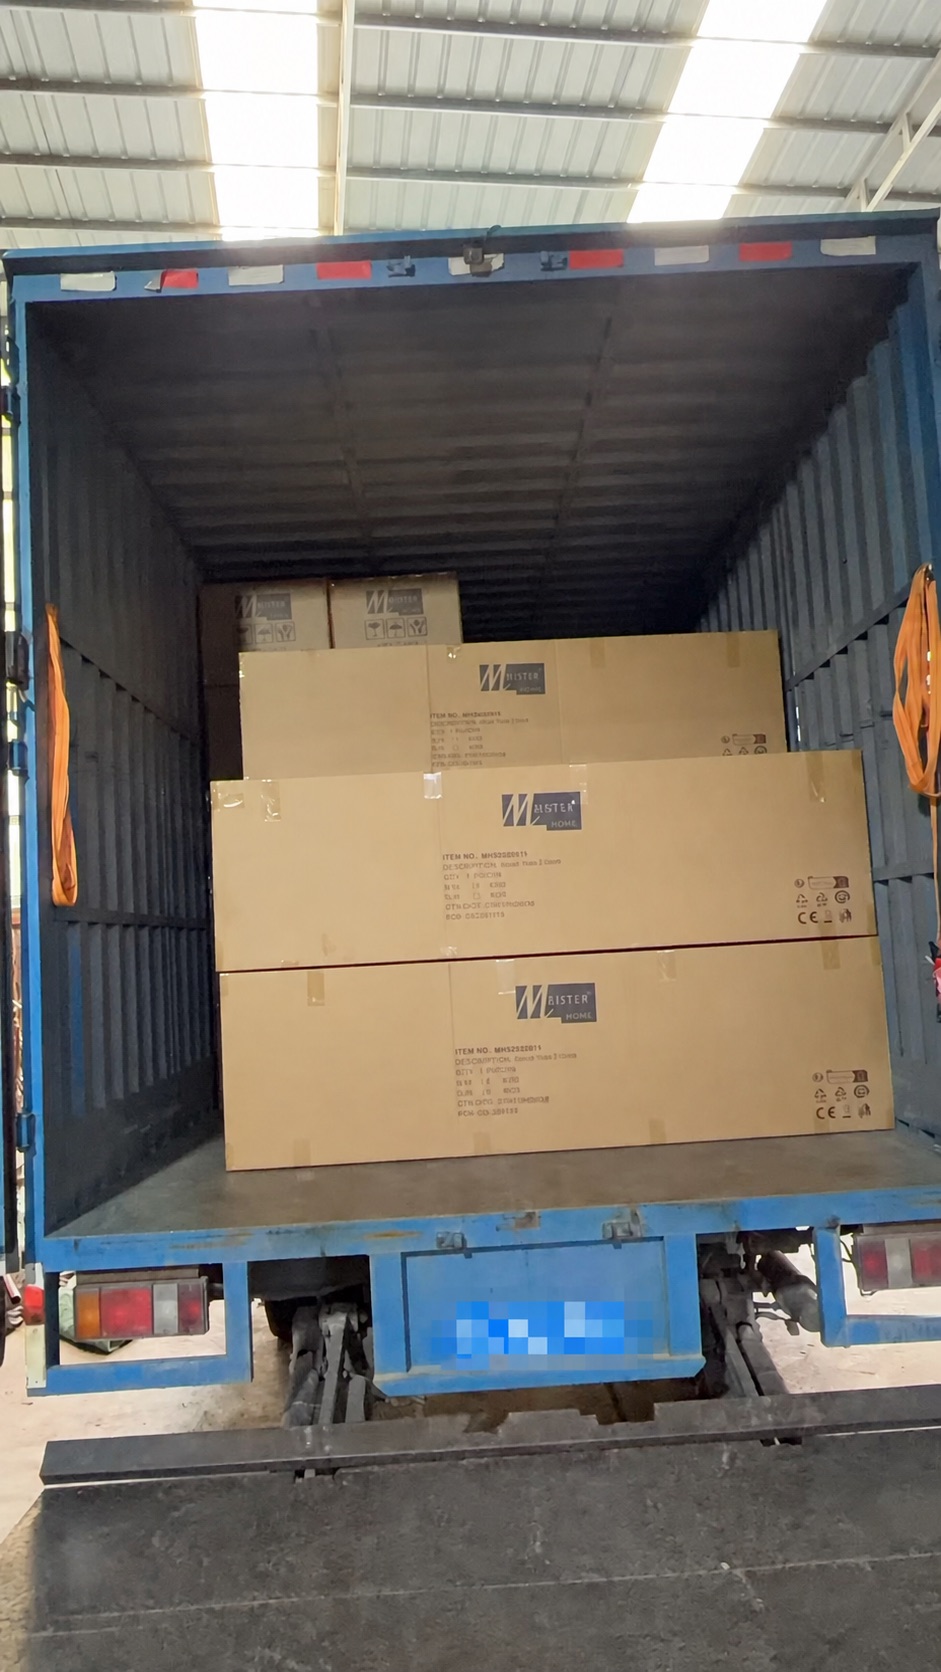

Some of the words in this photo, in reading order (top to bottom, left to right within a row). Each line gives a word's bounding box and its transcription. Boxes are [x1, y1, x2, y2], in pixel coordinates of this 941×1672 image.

[551, 820, 578, 828] HOME
[442, 853, 462, 861] ITEM
[566, 1012, 592, 1021] HOME
[455, 1047, 474, 1055] ITEM
